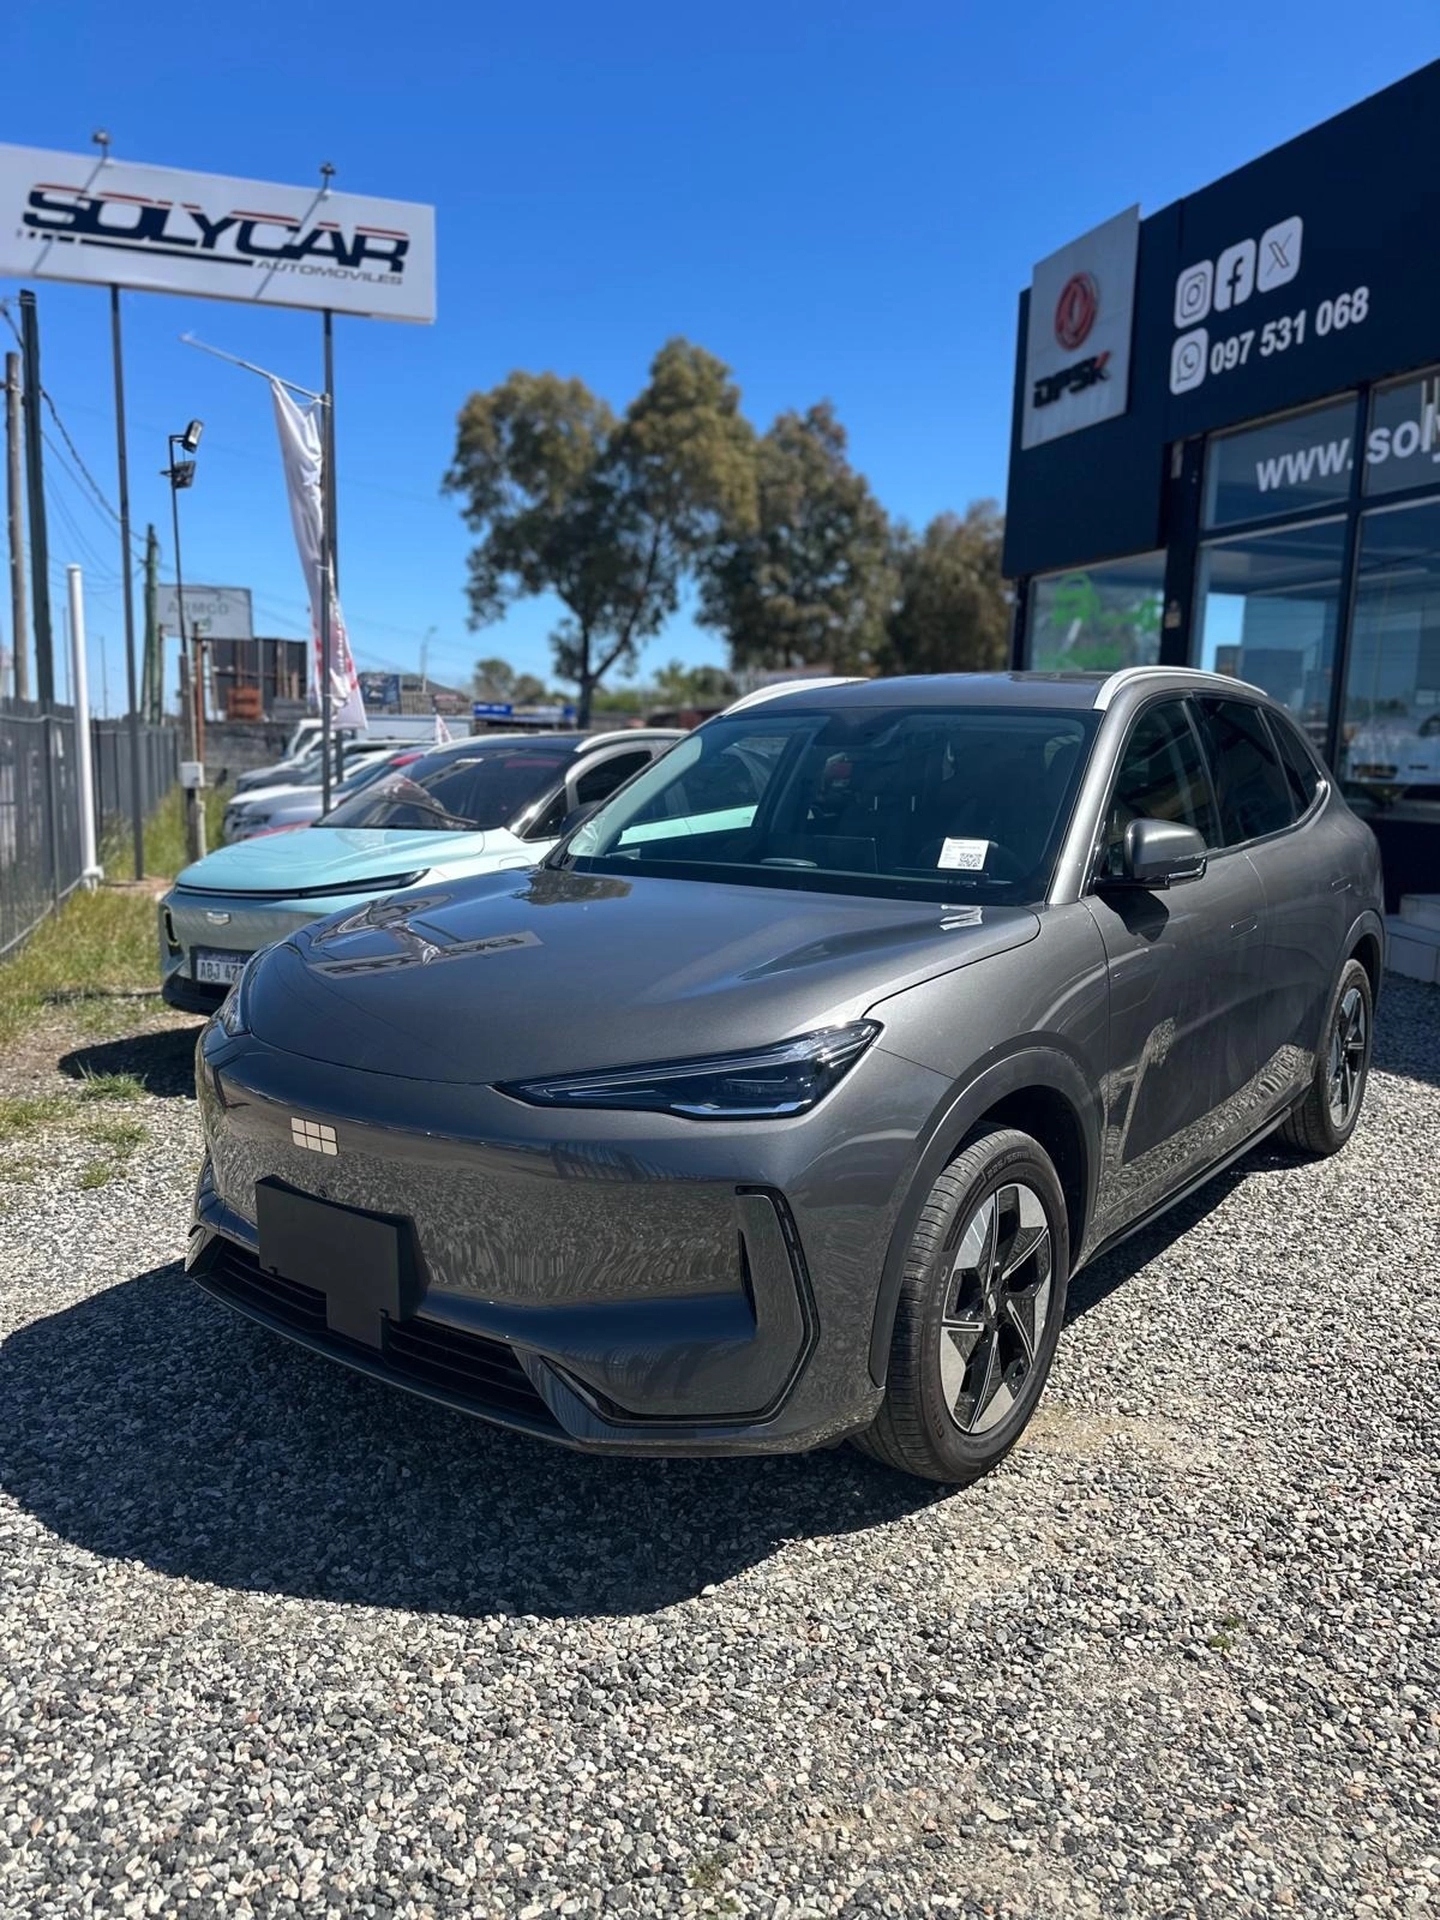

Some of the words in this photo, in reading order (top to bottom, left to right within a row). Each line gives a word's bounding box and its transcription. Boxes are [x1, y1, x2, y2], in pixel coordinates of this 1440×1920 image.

[23, 183, 411, 272] SOLYCAR
[257, 258, 403, 286] AUTOMOVILES
[1210, 330, 1255, 375] 097
[1259, 309, 1306, 357] 531
[1315, 286, 1369, 336] 068
[200, 962, 220, 980] ABJ
[225, 964, 245, 981] 47
